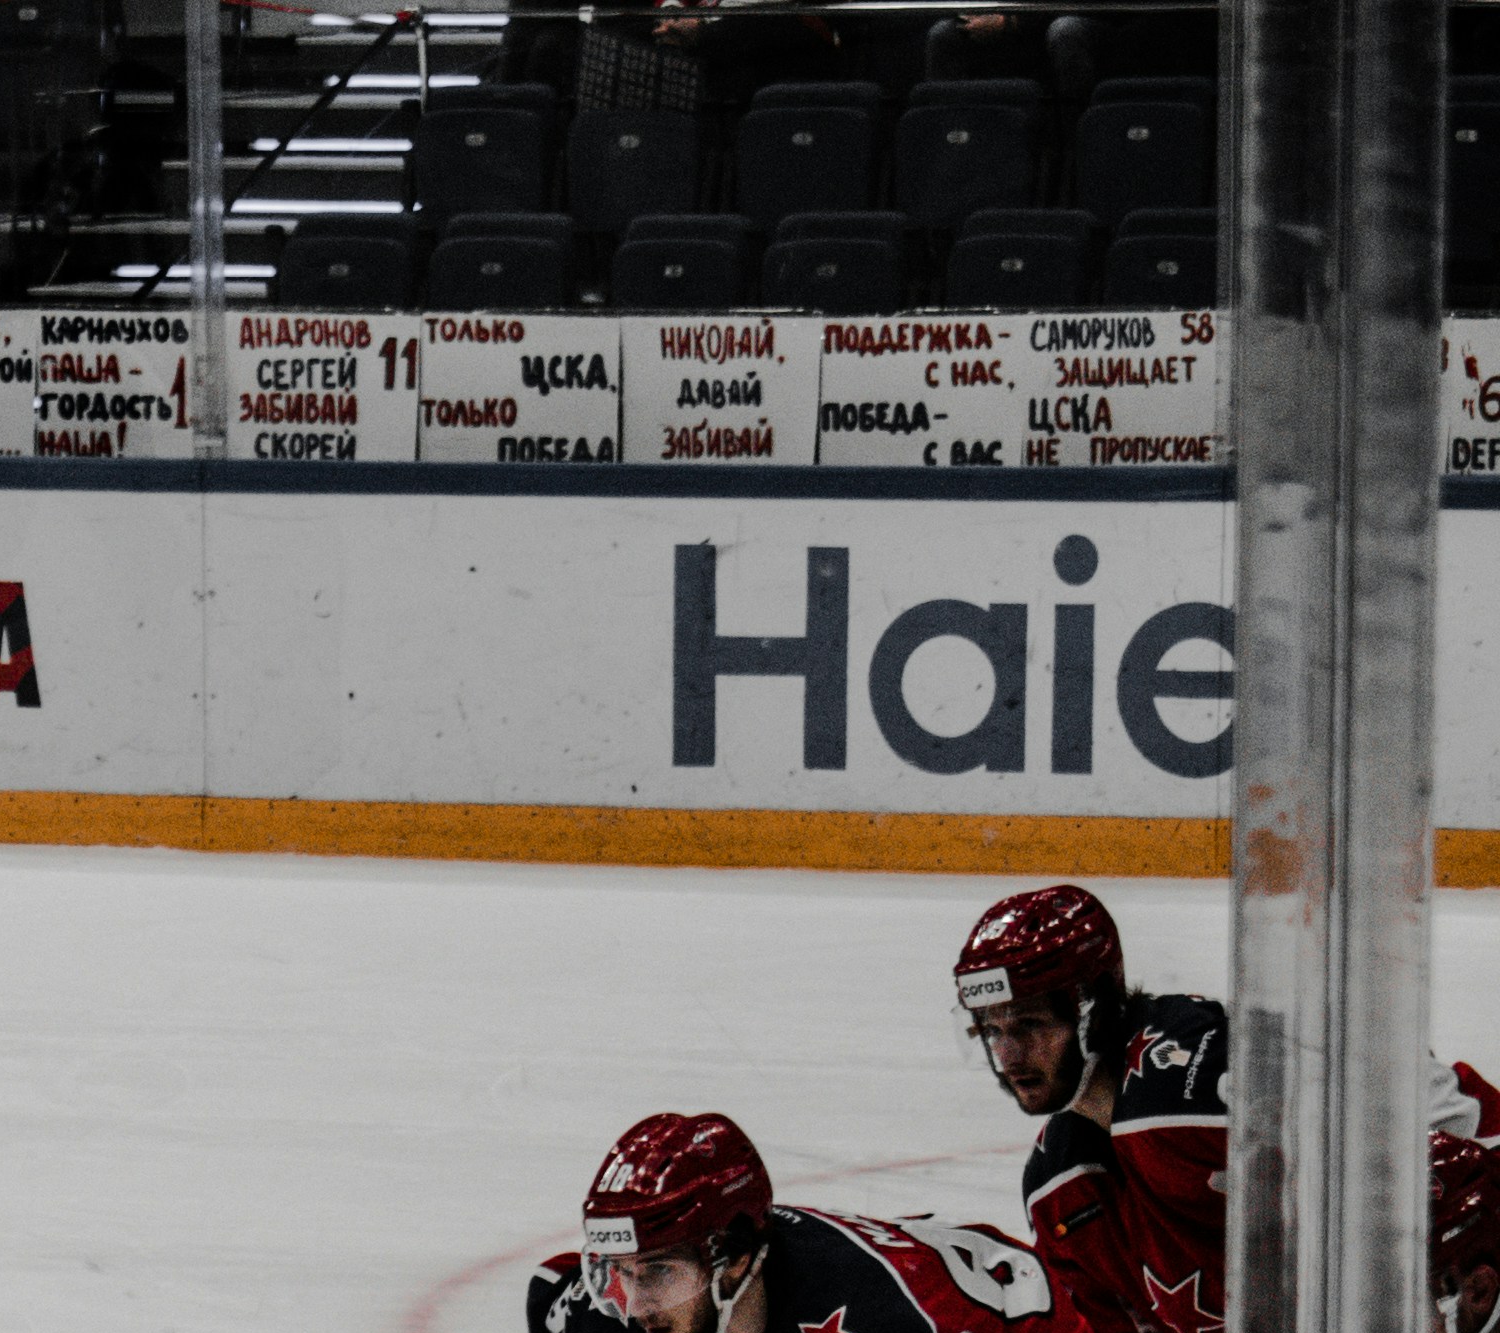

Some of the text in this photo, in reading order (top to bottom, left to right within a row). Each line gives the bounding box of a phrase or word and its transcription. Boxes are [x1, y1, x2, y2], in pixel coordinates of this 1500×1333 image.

[41, 315, 188, 345] КАРНАУХОВ
[239, 317, 371, 349] АНДРОНОВ
[424, 317, 525, 344] ТОЛЬКО
[1030, 312, 1215, 352] САМОРУКОВ 58
[257, 352, 357, 391] СЕРГЕЙ
[379, 337, 418, 390] 11
[1054, 356, 1197, 389] ЗАЩИЩАЕТ
[239, 388, 358, 425] ЗАБИВАЙ
[676, 371, 762, 409] ДАВАЙ
[39, 392, 172, 422] ГОРДОСТЬ
[421, 397, 517, 428] ТОЛЬКО
[1028, 393, 1113, 435] ЦСКА
[38, 422, 128, 459] НАША!
[254, 429, 356, 461] СКОРЕЙ
[498, 436, 615, 463] ПОБЕДА
[661, 417, 773, 460] ЗАБИВАЙ
[950, 440, 1003, 466] ВАС
[1026, 434, 1214, 466] НЕ ПРОПУСКАЕ
[672, 533, 1239, 777] Haie
